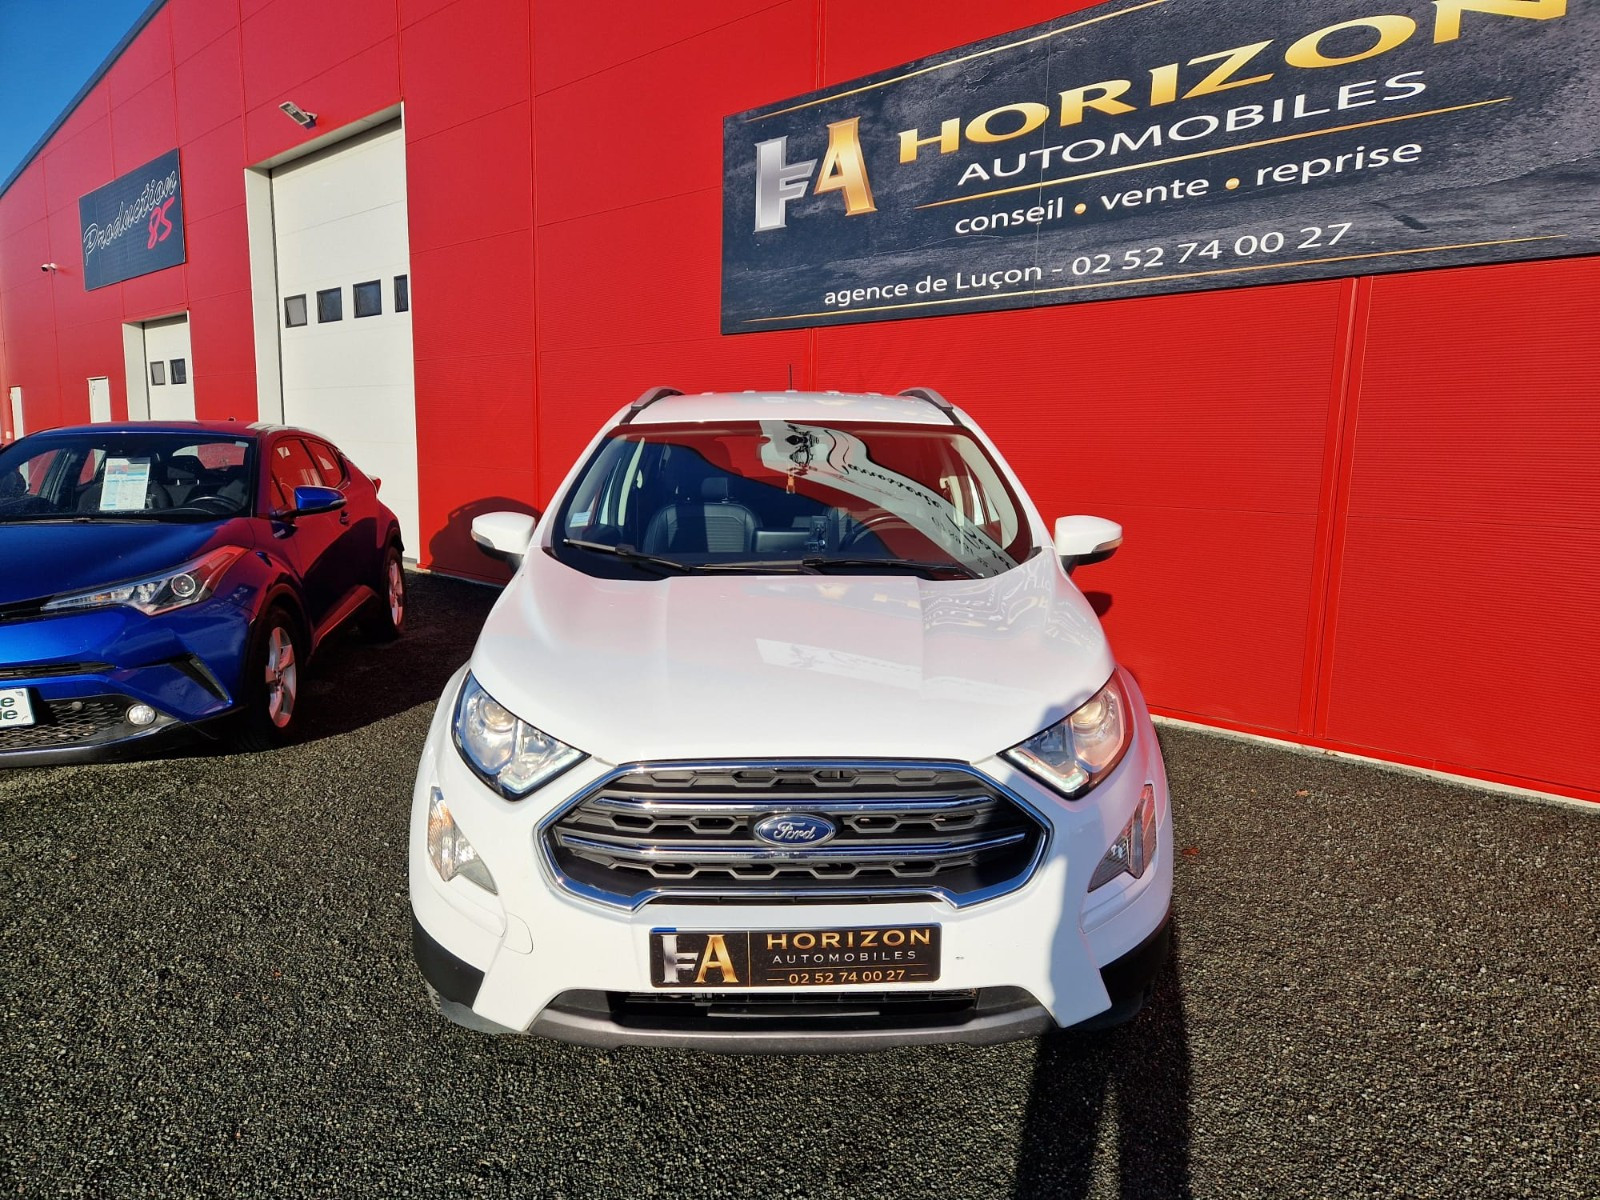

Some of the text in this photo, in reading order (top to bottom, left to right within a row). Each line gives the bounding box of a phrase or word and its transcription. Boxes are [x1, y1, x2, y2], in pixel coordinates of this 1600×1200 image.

[898, 0, 1567, 164] HORIZON
[957, 70, 1426, 186] AUTOMOBILES
[83, 171, 177, 265] Production
[955, 143, 1423, 235] conseil vente reprise
[147, 197, 174, 250] 85
[824, 284, 908, 307] agence
[915, 275, 948, 294] de
[956, 266, 1042, 290] Luçon
[1071, 253, 1111, 276] 02
[1123, 247, 1164, 270] 52
[1177, 240, 1223, 263] 74
[1234, 231, 1284, 256] 00
[1297, 223, 1353, 249] 27
[773, 821, 817, 840] Ford
[766, 929, 931, 950] HORIZON
[772, 951, 917, 964] AUTOMOBILES
[788, 970, 905, 984] 02 52 74 00 27
